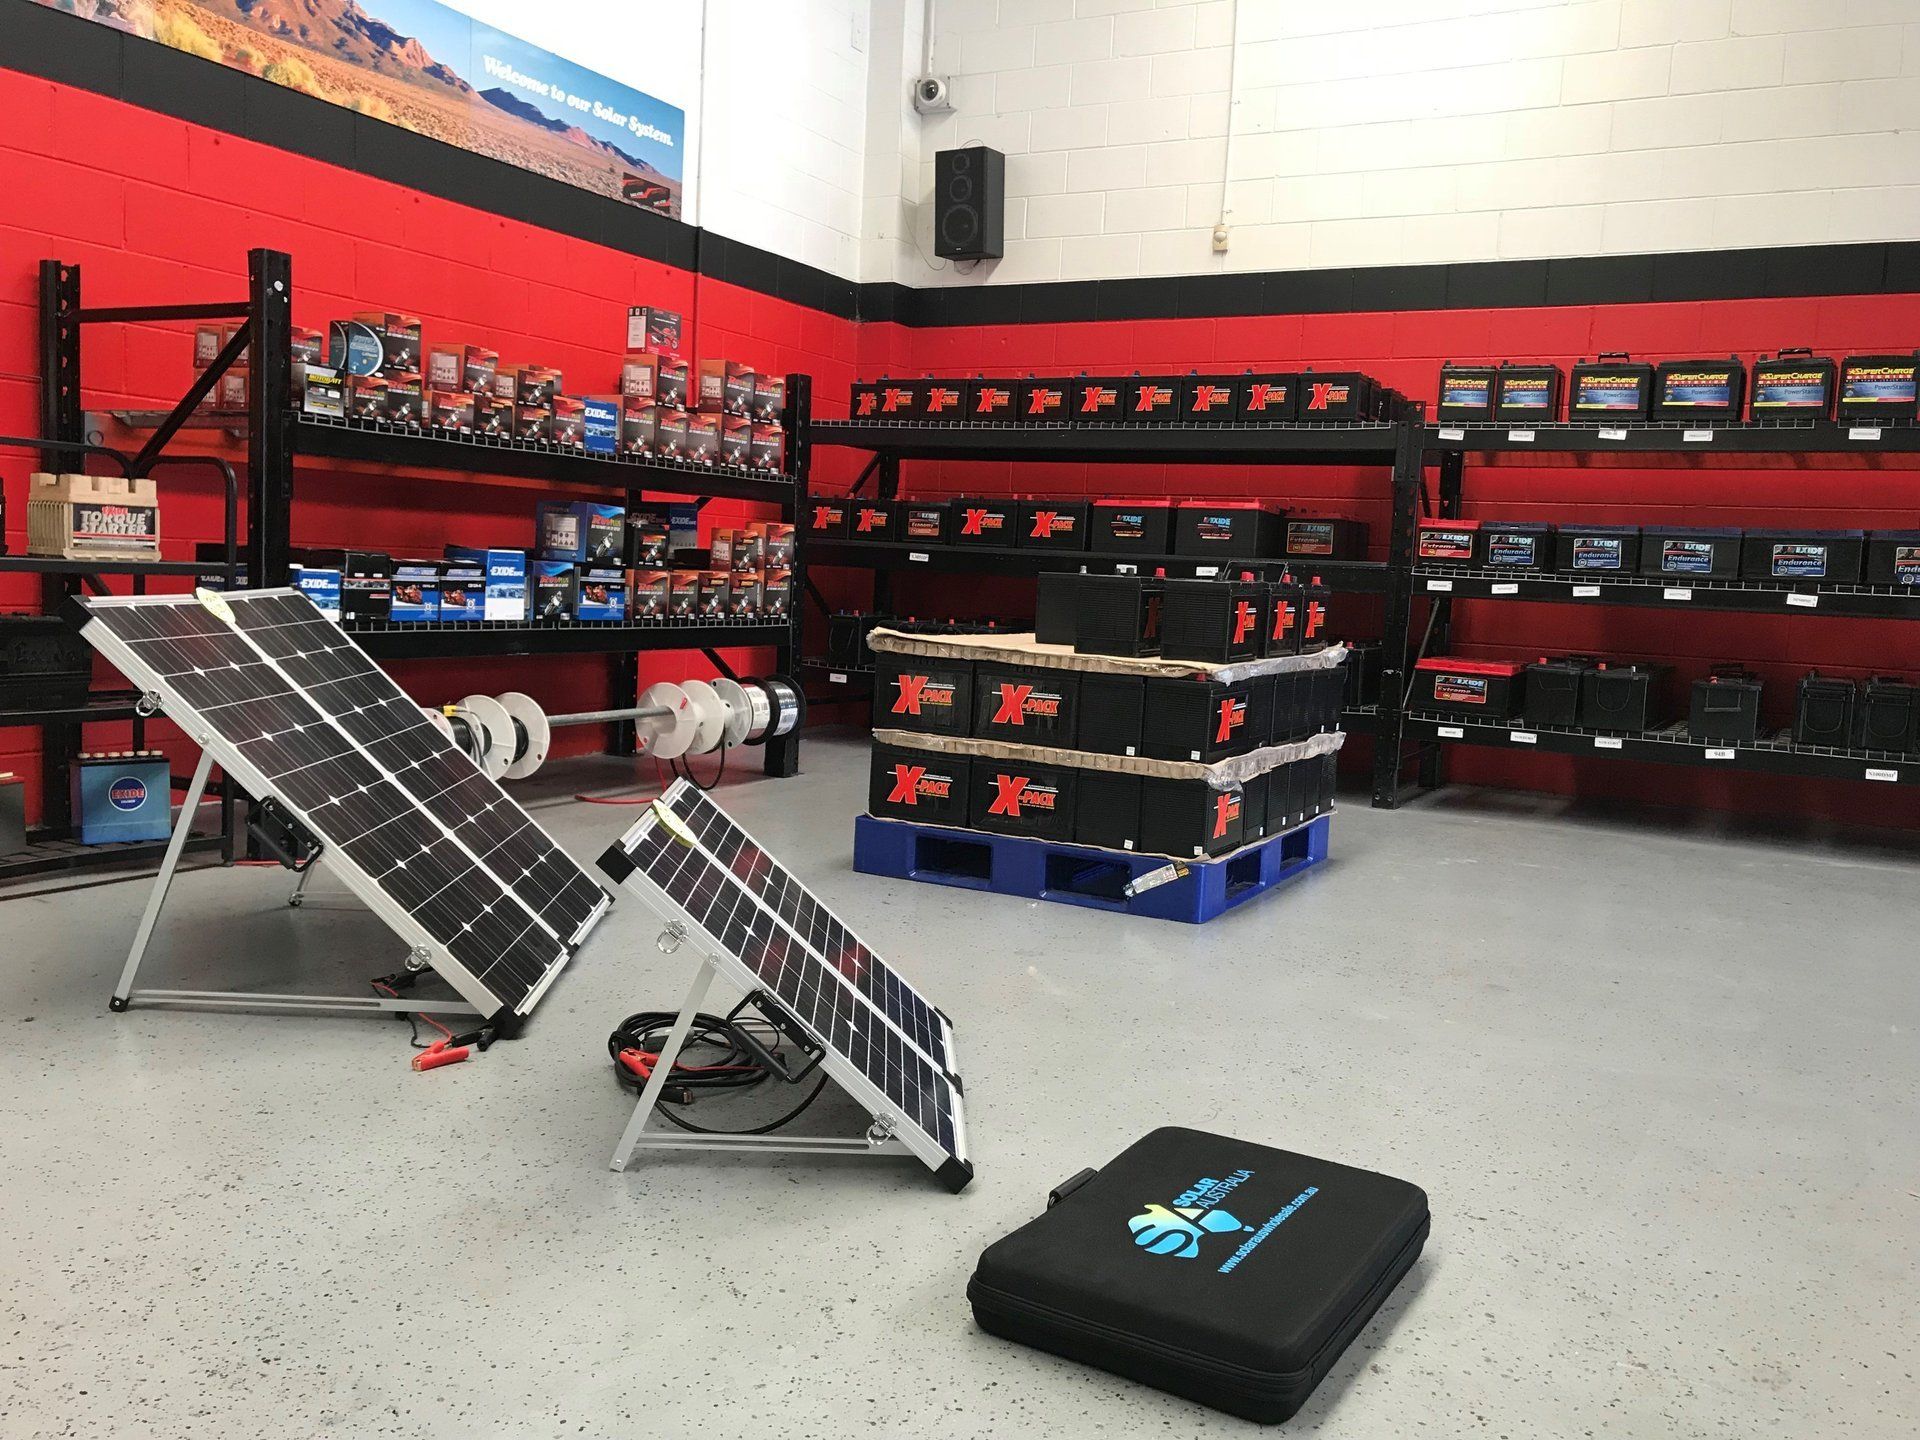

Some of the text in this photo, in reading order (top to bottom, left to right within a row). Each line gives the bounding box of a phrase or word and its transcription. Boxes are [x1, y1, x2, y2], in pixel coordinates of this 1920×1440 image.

[483, 54, 674, 147] Welcome to our Solar System.
[585, 407, 607, 419] EXIDE
[80, 510, 146, 525] TORQUE
[81, 523, 147, 535] STARTER
[1508, 536, 1533, 544] EXIDE
[1593, 540, 1619, 548] EXIDE
[1684, 543, 1711, 551] EXIDE
[1795, 546, 1825, 554] EXIDE
[1667, 554, 1709, 562] Endurance
[490, 566, 515, 576] EXIDE
[301, 578, 328, 588] EXIDE
[1458, 678, 1486, 687] EXIDE
[891, 674, 954, 716] X-PACK
[992, 683, 1060, 726] X-PACK
[887, 763, 951, 805] X-PACK
[111, 788, 145, 800] EXIDE
[988, 774, 1057, 817] X-PACK
[1172, 1177, 1220, 1208] SOLAR
[1195, 1168, 1256, 1209] AUSTRALIA
